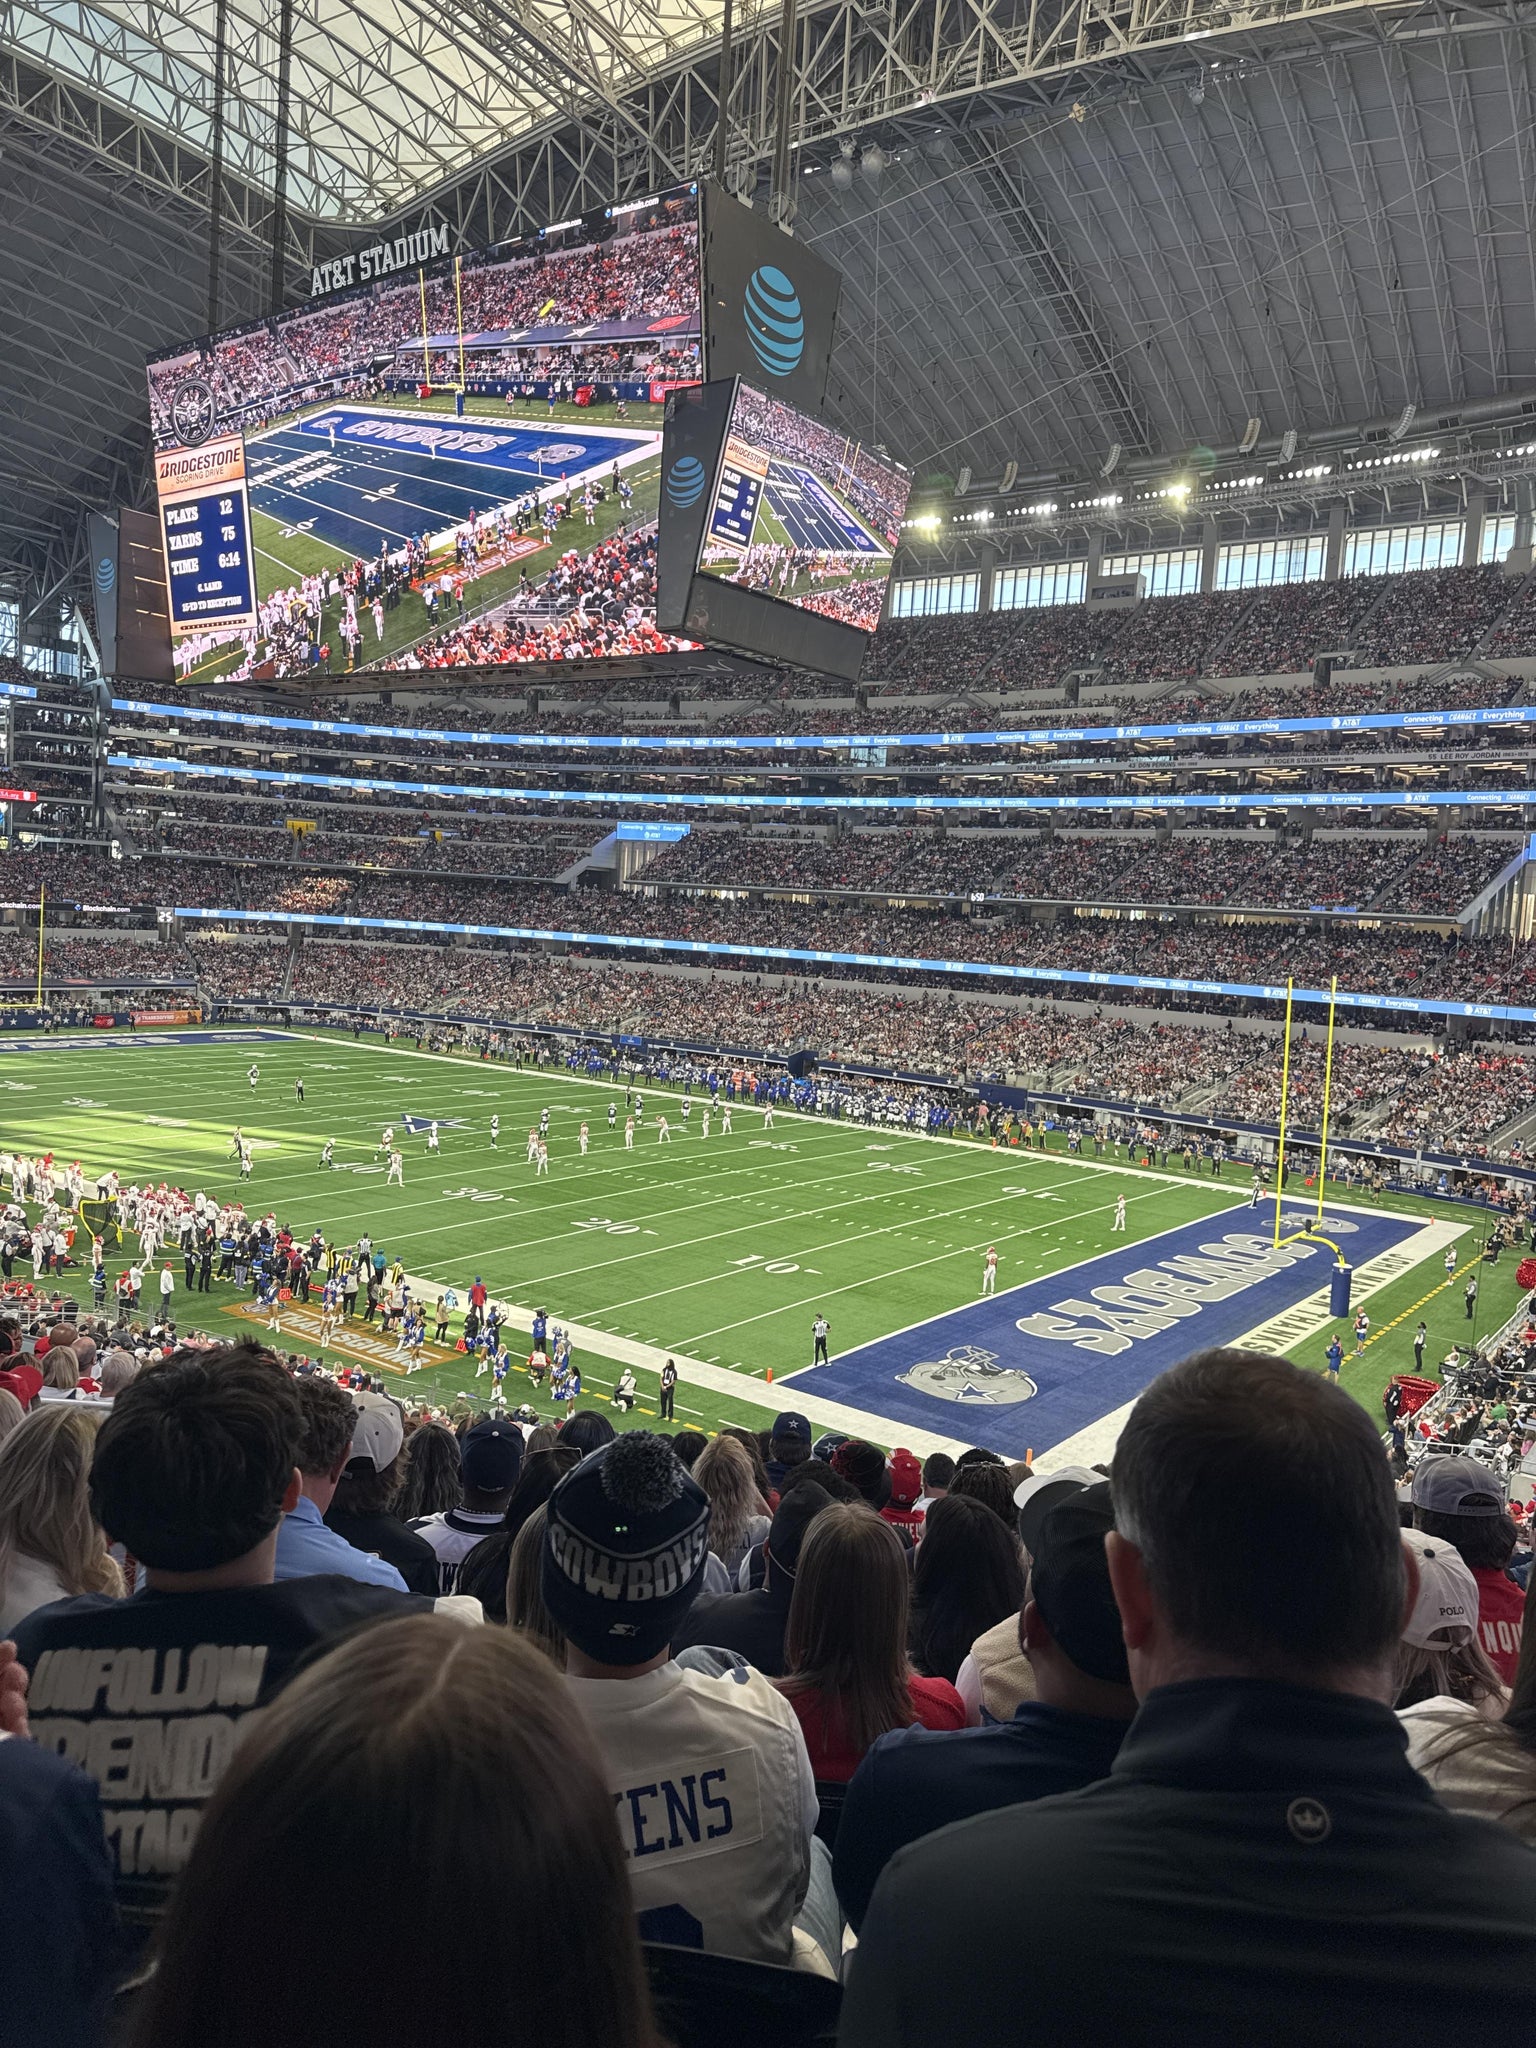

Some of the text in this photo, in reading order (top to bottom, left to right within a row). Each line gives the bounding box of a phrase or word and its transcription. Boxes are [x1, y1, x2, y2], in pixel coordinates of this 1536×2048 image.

[311, 223, 450, 297] AT&T STADIUM
[343, 420, 517, 453] COWBOYS
[728, 441, 768, 468] BRIDGESTONE
[160, 447, 241, 479] BRIDGESTONE
[175, 466, 224, 485] SCORING DRIVE
[167, 499, 233, 526] PLAYS 12
[279, 520, 313, 538] 20
[169, 526, 235, 551] YARDS 75
[171, 551, 240, 576] TIME 6:14
[16, 687, 31, 695] AT&T
[137, 703, 151, 711] AT&T
[183, 708, 213, 720] Connecting
[1403, 714, 1443, 724] Connecting
[1483, 710, 1525, 721] Everything
[320, 722, 334, 731] AT&T
[1177, 725, 1212, 735] Connecting
[1244, 722, 1279, 731] Everything
[1342, 718, 1361, 727] AT&T
[365, 726, 444, 741] Connecting Everything
[950, 735, 965, 743] AT&T
[996, 733, 1025, 742] Connecting
[1053, 730, 1084, 739] Everything
[1125, 728, 1141, 737] AT&T
[823, 737, 901, 746] Connecting Everything
[1471, 751, 1501, 759] JORDAN
[1226, 797, 1241, 805] AT&T
[1273, 796, 1303, 805] Connecting
[1332, 795, 1364, 804] Everything
[1467, 794, 1502, 802] Connecting
[0, 902, 41, 910] ckchain.com
[82, 905, 131, 913] Blockchain.com
[158, 911, 173, 922] 25
[1138, 978, 1166, 988] Connecting
[1192, 983, 1221, 993] Everything
[1385, 999, 1419, 1010] Everything
[1474, 1006, 1492, 1014] AT&T
[442, 1187, 504, 1201] 30
[570, 1217, 640, 1235] 20
[726, 1254, 800, 1274] 10
[1365, 1252, 1416, 1275] JOHN
[281, 1290, 289, 1299] 20
[1016, 1233, 1319, 1356] COWBOYS
[550, 1521, 707, 1601] COWBOYS
[1439, 1606, 1464, 1616] POLO
[28, 1643, 269, 1713] UNFOLLOW
[614, 1768, 733, 1858] ENS
